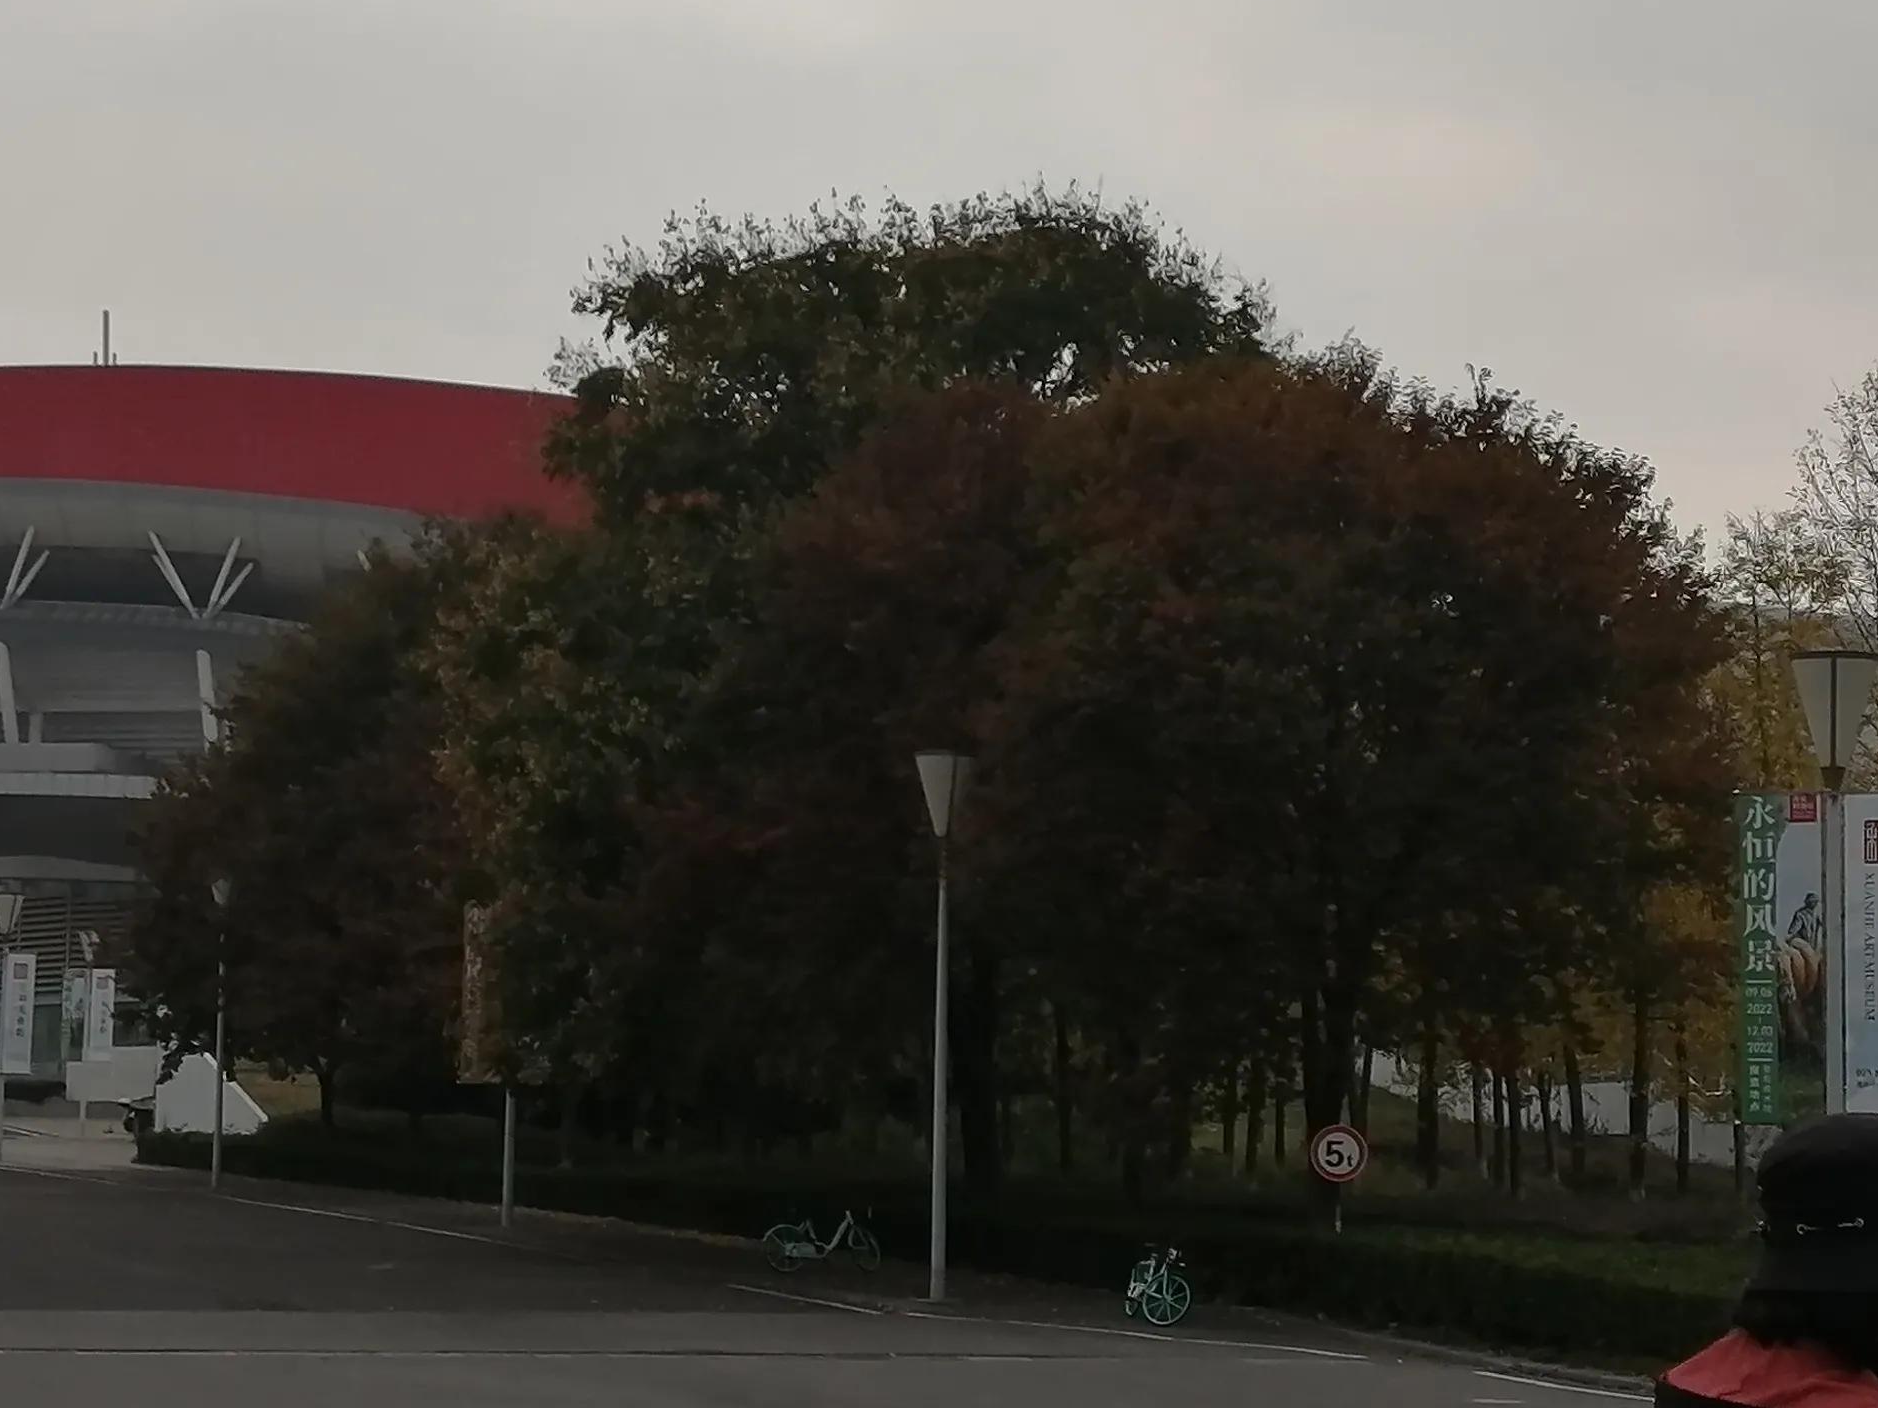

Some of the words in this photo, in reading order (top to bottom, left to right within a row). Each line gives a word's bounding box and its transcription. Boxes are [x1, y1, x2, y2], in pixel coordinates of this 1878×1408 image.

[1742, 796, 1778, 972] 永恒的风景
[1746, 1003, 1773, 1015] 2022
